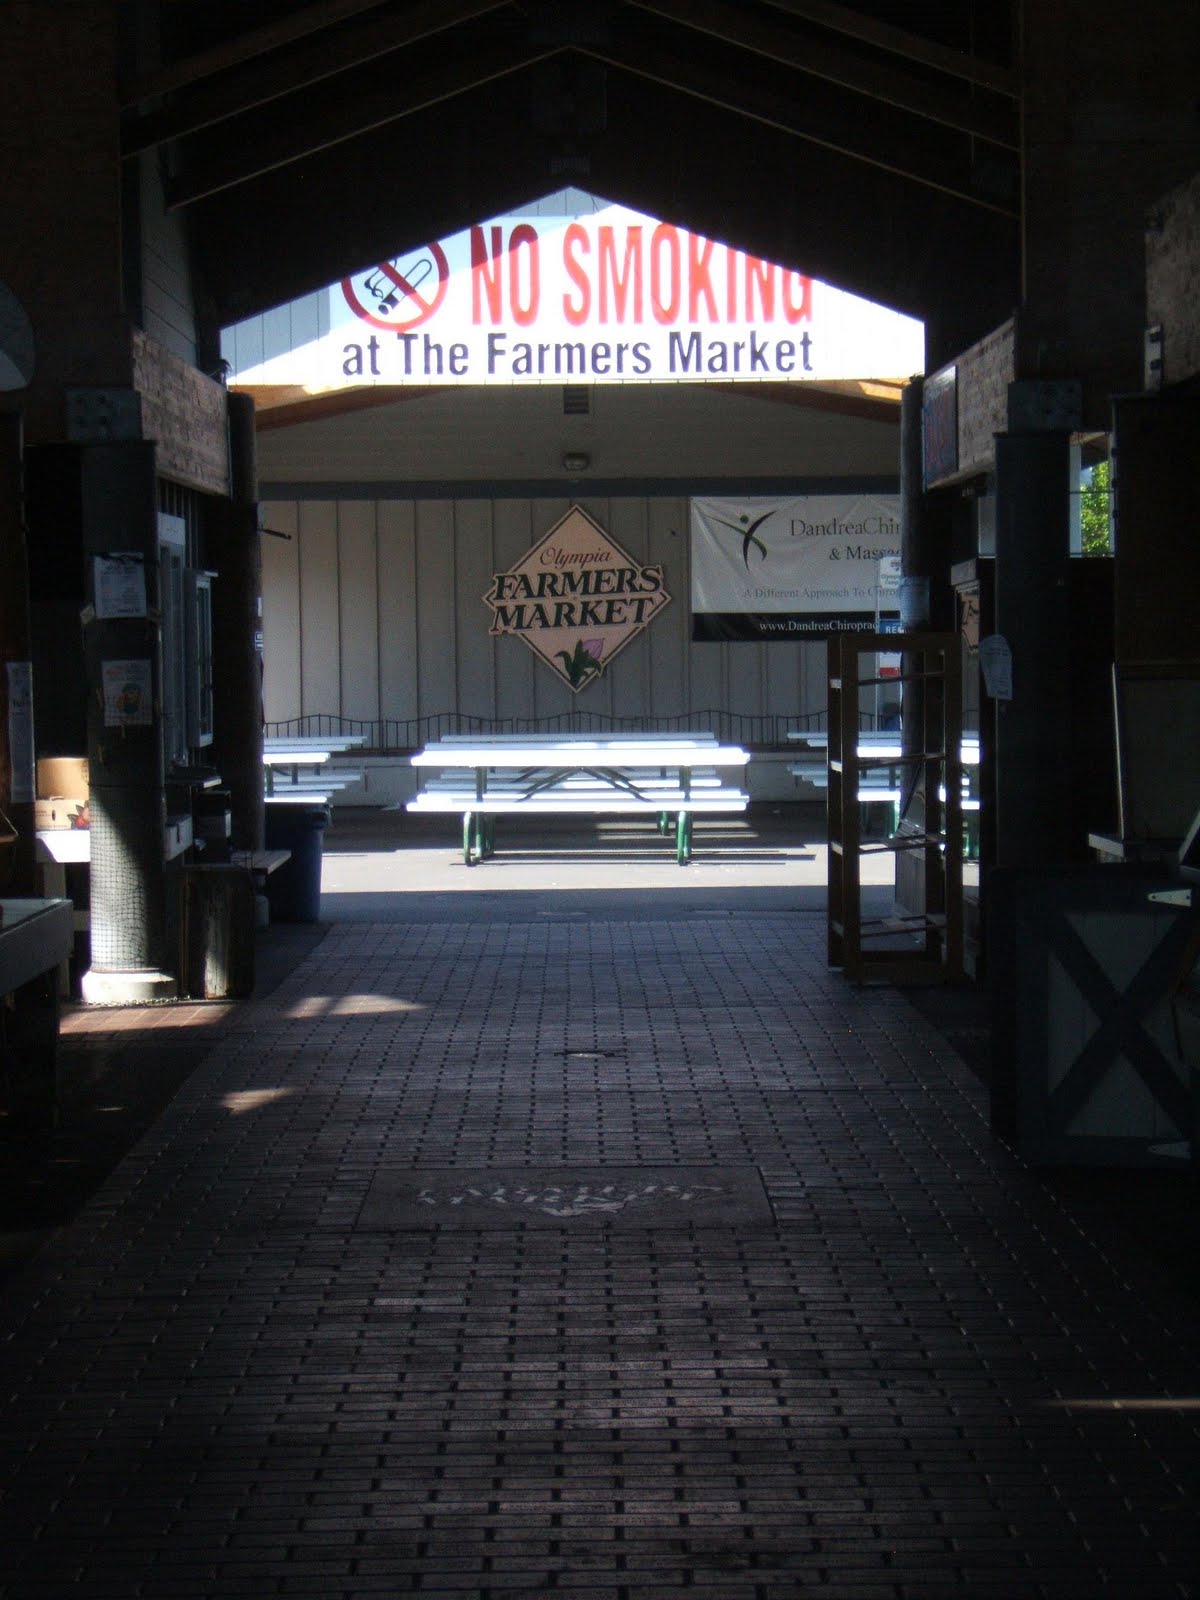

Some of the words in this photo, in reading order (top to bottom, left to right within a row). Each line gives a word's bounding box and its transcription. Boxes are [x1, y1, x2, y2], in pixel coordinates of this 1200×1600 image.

[470, 223, 540, 327] NO
[342, 335, 381, 376] at
[397, 332, 469, 376] The
[487, 332, 653, 376] Farmers
[668, 330, 814, 374] Market
[540, 548, 612, 569] Olympia
[829, 548, 841, 561] &
[492, 567, 662, 601] FARMERS
[743, 588, 752, 598] A
[754, 587, 799, 599] Different
[802, 587, 850, 600] Approach
[853, 587, 865, 598] To
[490, 597, 655, 632] MARKET
